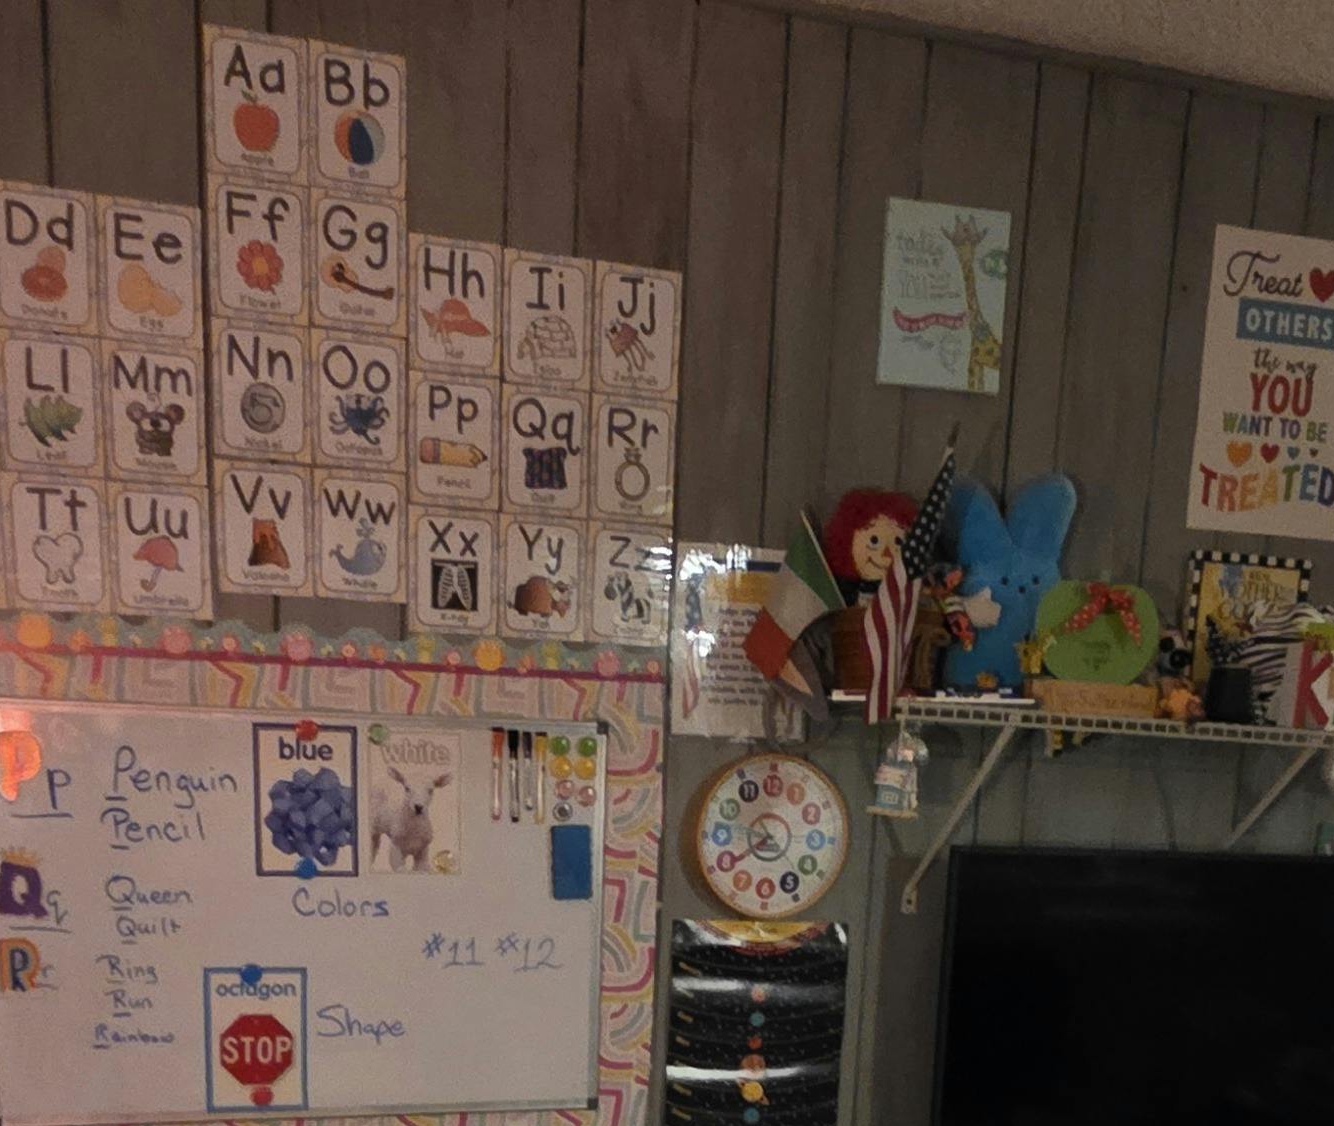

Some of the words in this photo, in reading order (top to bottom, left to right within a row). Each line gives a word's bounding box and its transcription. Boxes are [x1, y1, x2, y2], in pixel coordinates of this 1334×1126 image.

[224, 44, 286, 96] Aa
[324, 58, 390, 111] Bb
[4, 198, 75, 253] Dd
[112, 211, 183, 264] Ee
[225, 190, 290, 242] Ff
[322, 204, 390, 271] Gg
[422, 247, 486, 299] Hh
[525, 266, 566, 311] Ii
[1223, 251, 1304, 297] Treat
[616, 276, 657, 336] Jj
[1245, 308, 1334, 342] OTHERS
[112, 354, 193, 397] Mm
[226, 333, 295, 383] Nn
[323, 344, 391, 395] Oo
[427, 385, 480, 434] Pp
[1250, 372, 1314, 417] YOU
[512, 399, 581, 457] Qq
[607, 407, 659, 449] Rr
[1222, 411, 1273, 437] WANT
[1279, 417, 1301, 440] TO
[1306, 421, 1330, 442] BE
[25, 486, 87, 531] Tt
[123, 495, 190, 540] Uu
[229, 473, 292, 520] Vv
[323, 487, 397, 527] Ww
[427, 519, 480, 558] Xx
[518, 525, 565, 576] Yy
[278, 735, 333, 761] blue
[380, 739, 451, 766] white
[111, 744, 238, 809] Penguin
[100, 807, 206, 843] Pencil
[104, 875, 193, 909] Queen
[292, 886, 390, 918] Colors
[116, 919, 182, 938] Quilt
[96, 953, 159, 984] Ring
[105, 990, 154, 1011] Run
[316, 1004, 406, 1046] Shape
[222, 1036, 293, 1066] STOP
